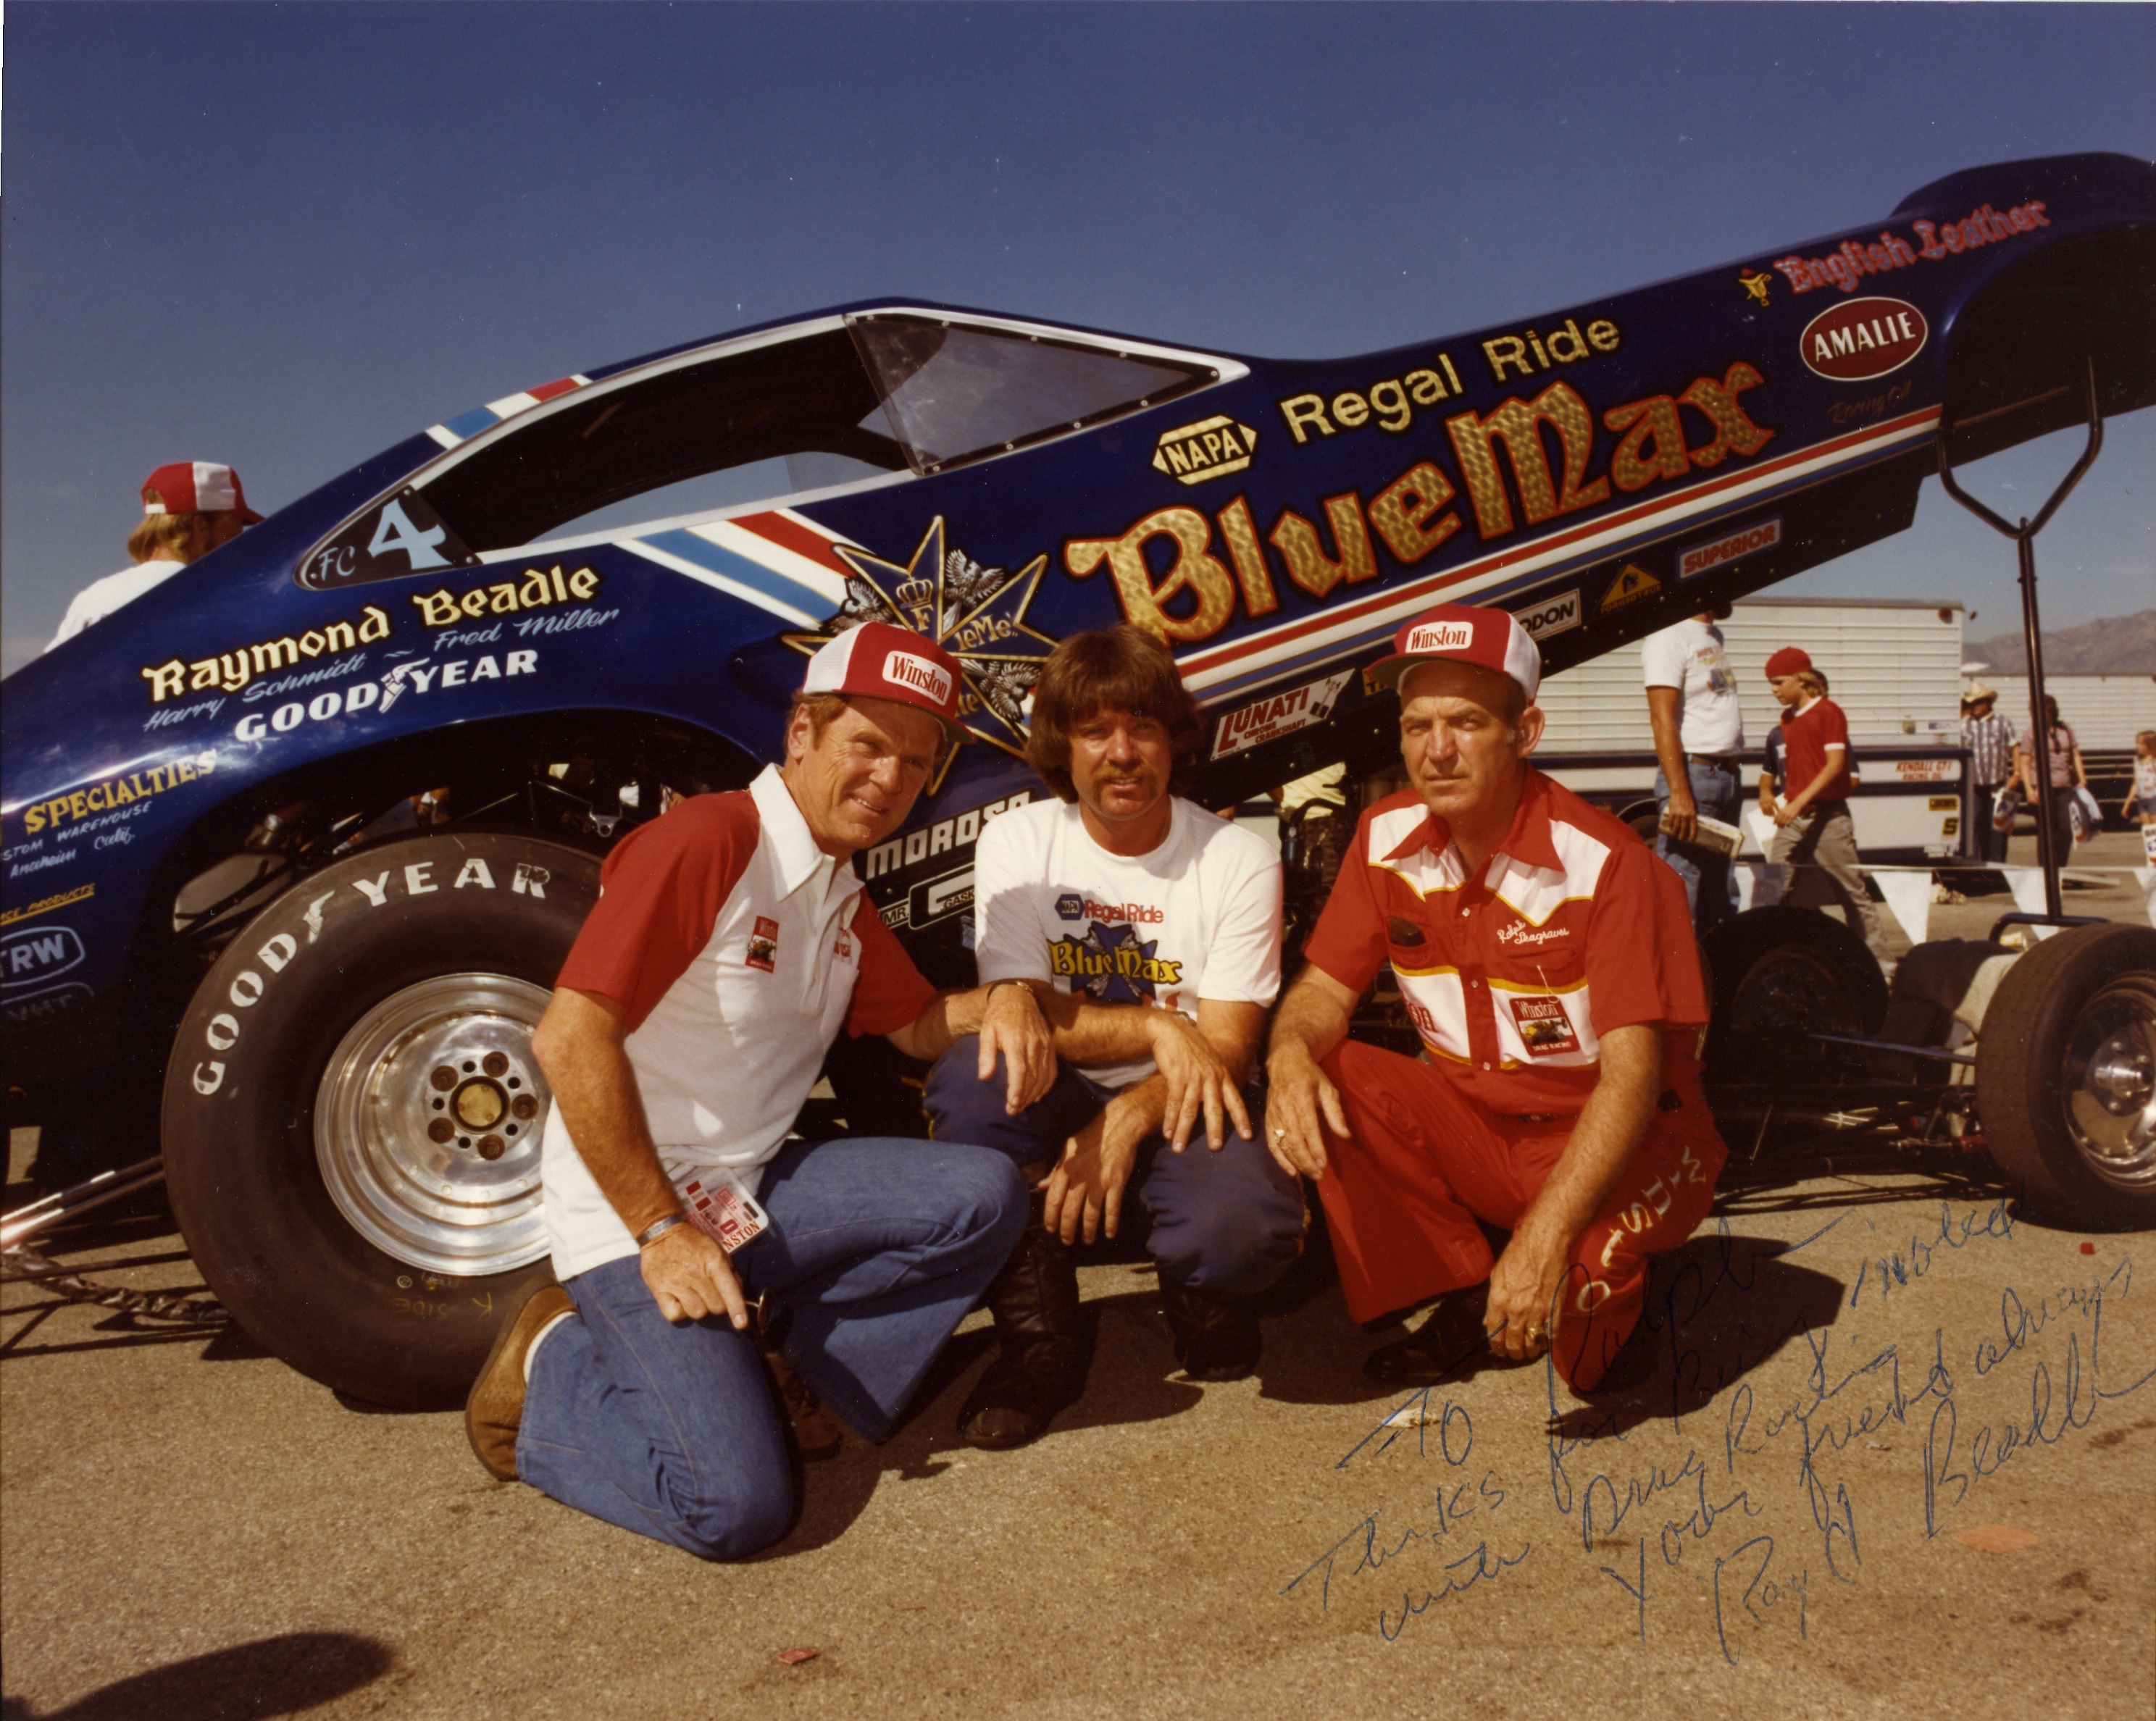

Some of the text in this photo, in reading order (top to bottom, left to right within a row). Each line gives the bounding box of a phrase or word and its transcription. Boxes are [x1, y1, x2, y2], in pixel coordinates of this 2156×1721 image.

[1773, 201, 2051, 293] English Leather
[1814, 311, 1916, 363] AMALIE
[1280, 318, 1621, 443] Regal Ride
[1163, 432, 1242, 474] NAPA
[319, 498, 454, 581] FC 4
[1684, 522, 1776, 576] SUPERIOR
[142, 564, 599, 703] Raymond Beadle
[434, 608, 620, 651] Fred Miller
[1408, 624, 1468, 652] Winston
[143, 653, 367, 732] Harry Schmidt
[235, 649, 539, 742] GOODYEAR
[890, 655, 948, 700] Winston
[1218, 687, 1310, 753] LUNATI
[1243, 720, 1277, 740] CHROME
[1254, 718, 1307, 745] CRANKSHAFT
[24, 748, 218, 835] SPECIALTIES
[57, 800, 153, 842] WAREHOUSE
[10, 826, 135, 879] Anaheim Calif.
[27, 883, 96, 913] PRODUCTS
[1061, 899, 1164, 924] NAPA Regal Ride
[1497, 918, 1526, 944] Ralph
[1513, 927, 1570, 945] Seagraves
[193, 858, 551, 1096] GOODYEAR
[1049, 940, 1183, 985] Blue Max
[1514, 1000, 1559, 1018] Winston
